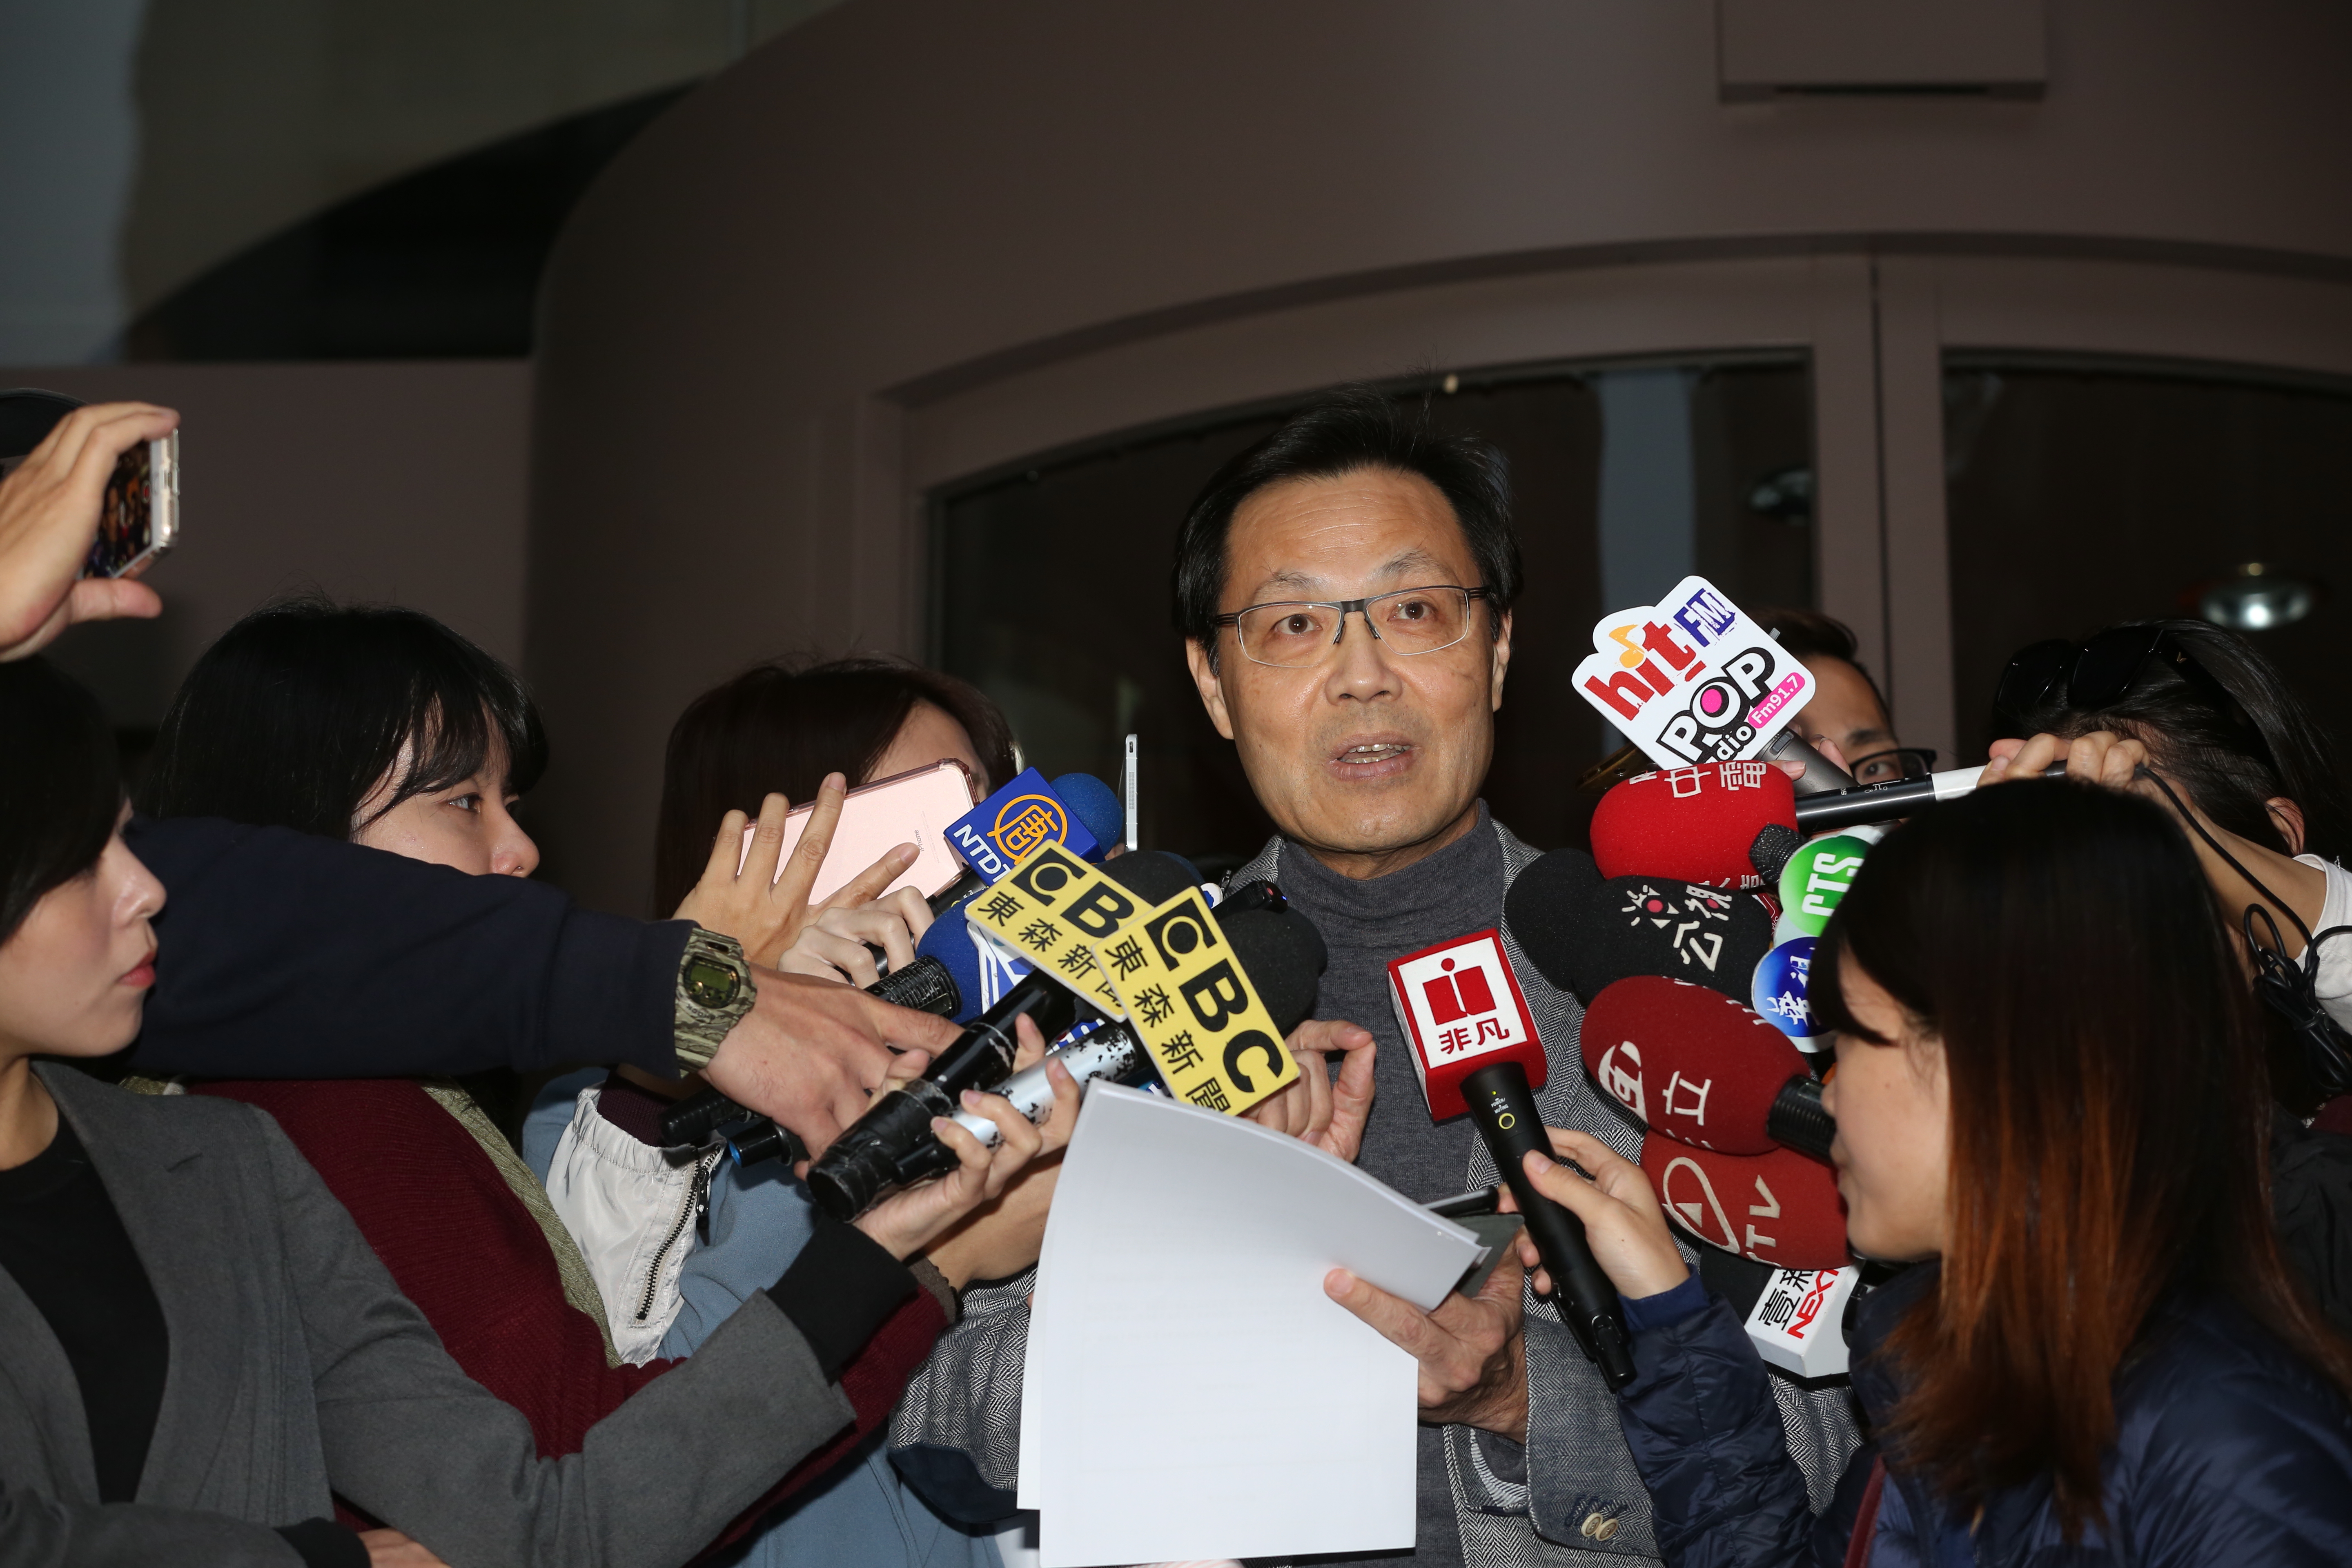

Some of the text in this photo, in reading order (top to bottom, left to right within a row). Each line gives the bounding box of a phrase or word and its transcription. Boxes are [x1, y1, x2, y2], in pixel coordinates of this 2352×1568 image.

[1584, 588, 1735, 721] hit FM
[1656, 647, 1775, 764] POP
[1751, 675, 1800, 725] Fm91.7
[1713, 725, 1752, 763] dio
[1105, 935, 1232, 1113] 東森新聞
[1439, 1018, 1510, 1055] 非凡
